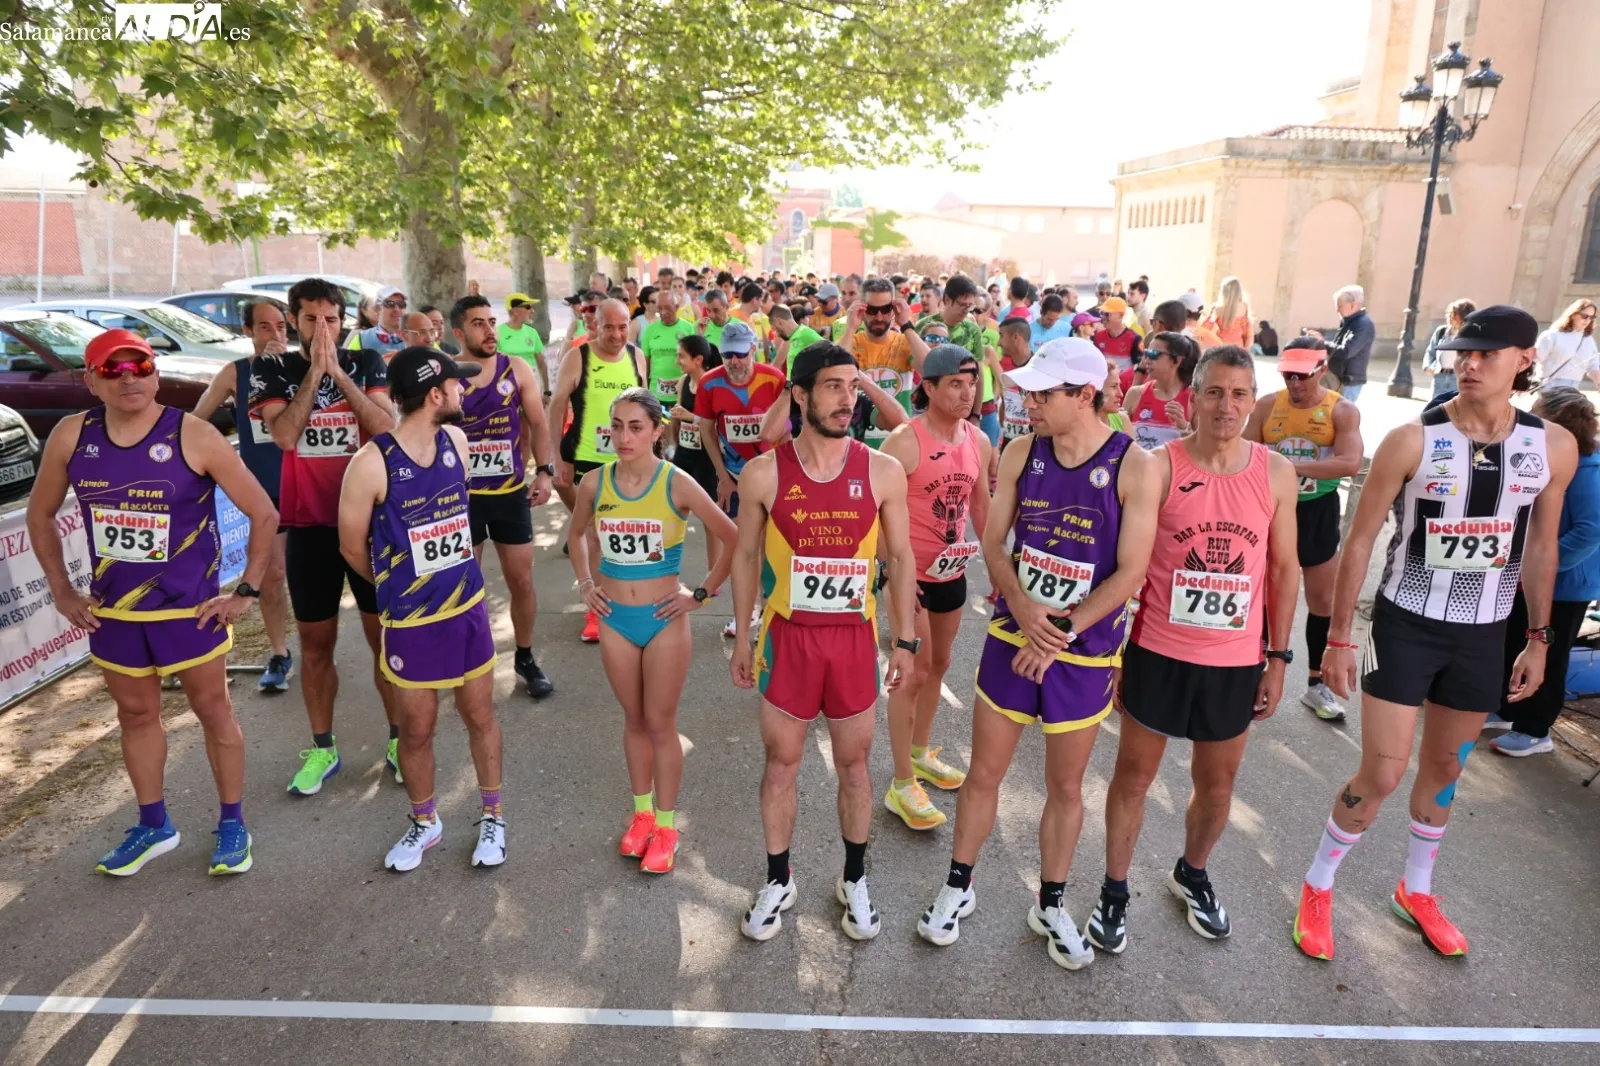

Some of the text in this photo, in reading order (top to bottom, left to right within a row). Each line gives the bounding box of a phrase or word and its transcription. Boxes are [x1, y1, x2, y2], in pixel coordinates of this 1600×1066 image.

[308, 415, 357, 427] dunia
[305, 427, 349, 447] 882
[732, 424, 761, 436] 960
[469, 443, 511, 452] edunia
[469, 452, 505, 469] 794
[78, 479, 109, 488] Jamón
[924, 479, 942, 494] BAR
[942, 475, 952, 484] LA
[947, 486, 963, 495] RUN
[128, 489, 164, 498] PRIM
[438, 492, 460, 506] PRIM
[119, 502, 170, 511] Macotera
[810, 511, 860, 520] CAJA RURAL
[1062, 513, 1093, 529] PRIM
[410, 518, 468, 543] bedunia
[600, 520, 661, 533] bedunia
[809, 526, 842, 536] VINO
[1173, 521, 1260, 548] BAR LA ESCAPADA
[1428, 519, 1513, 535] bedunia
[104, 526, 154, 551] 953
[798, 536, 853, 548] DE TORO
[1053, 526, 1096, 545] Macotera
[1207, 537, 1232, 550] RUN
[424, 532, 464, 562] 862
[609, 534, 649, 555] 831
[941, 545, 978, 557] dunia
[1441, 535, 1500, 560] 793
[1021, 549, 1092, 581] bedunia
[1205, 551, 1230, 565] CLUB
[793, 559, 867, 576] bedunia
[803, 575, 855, 600] 964
[1026, 567, 1078, 602] 787
[1175, 573, 1250, 592] bedunia
[10, 587, 24, 601] DE
[1185, 590, 1238, 617] 786
